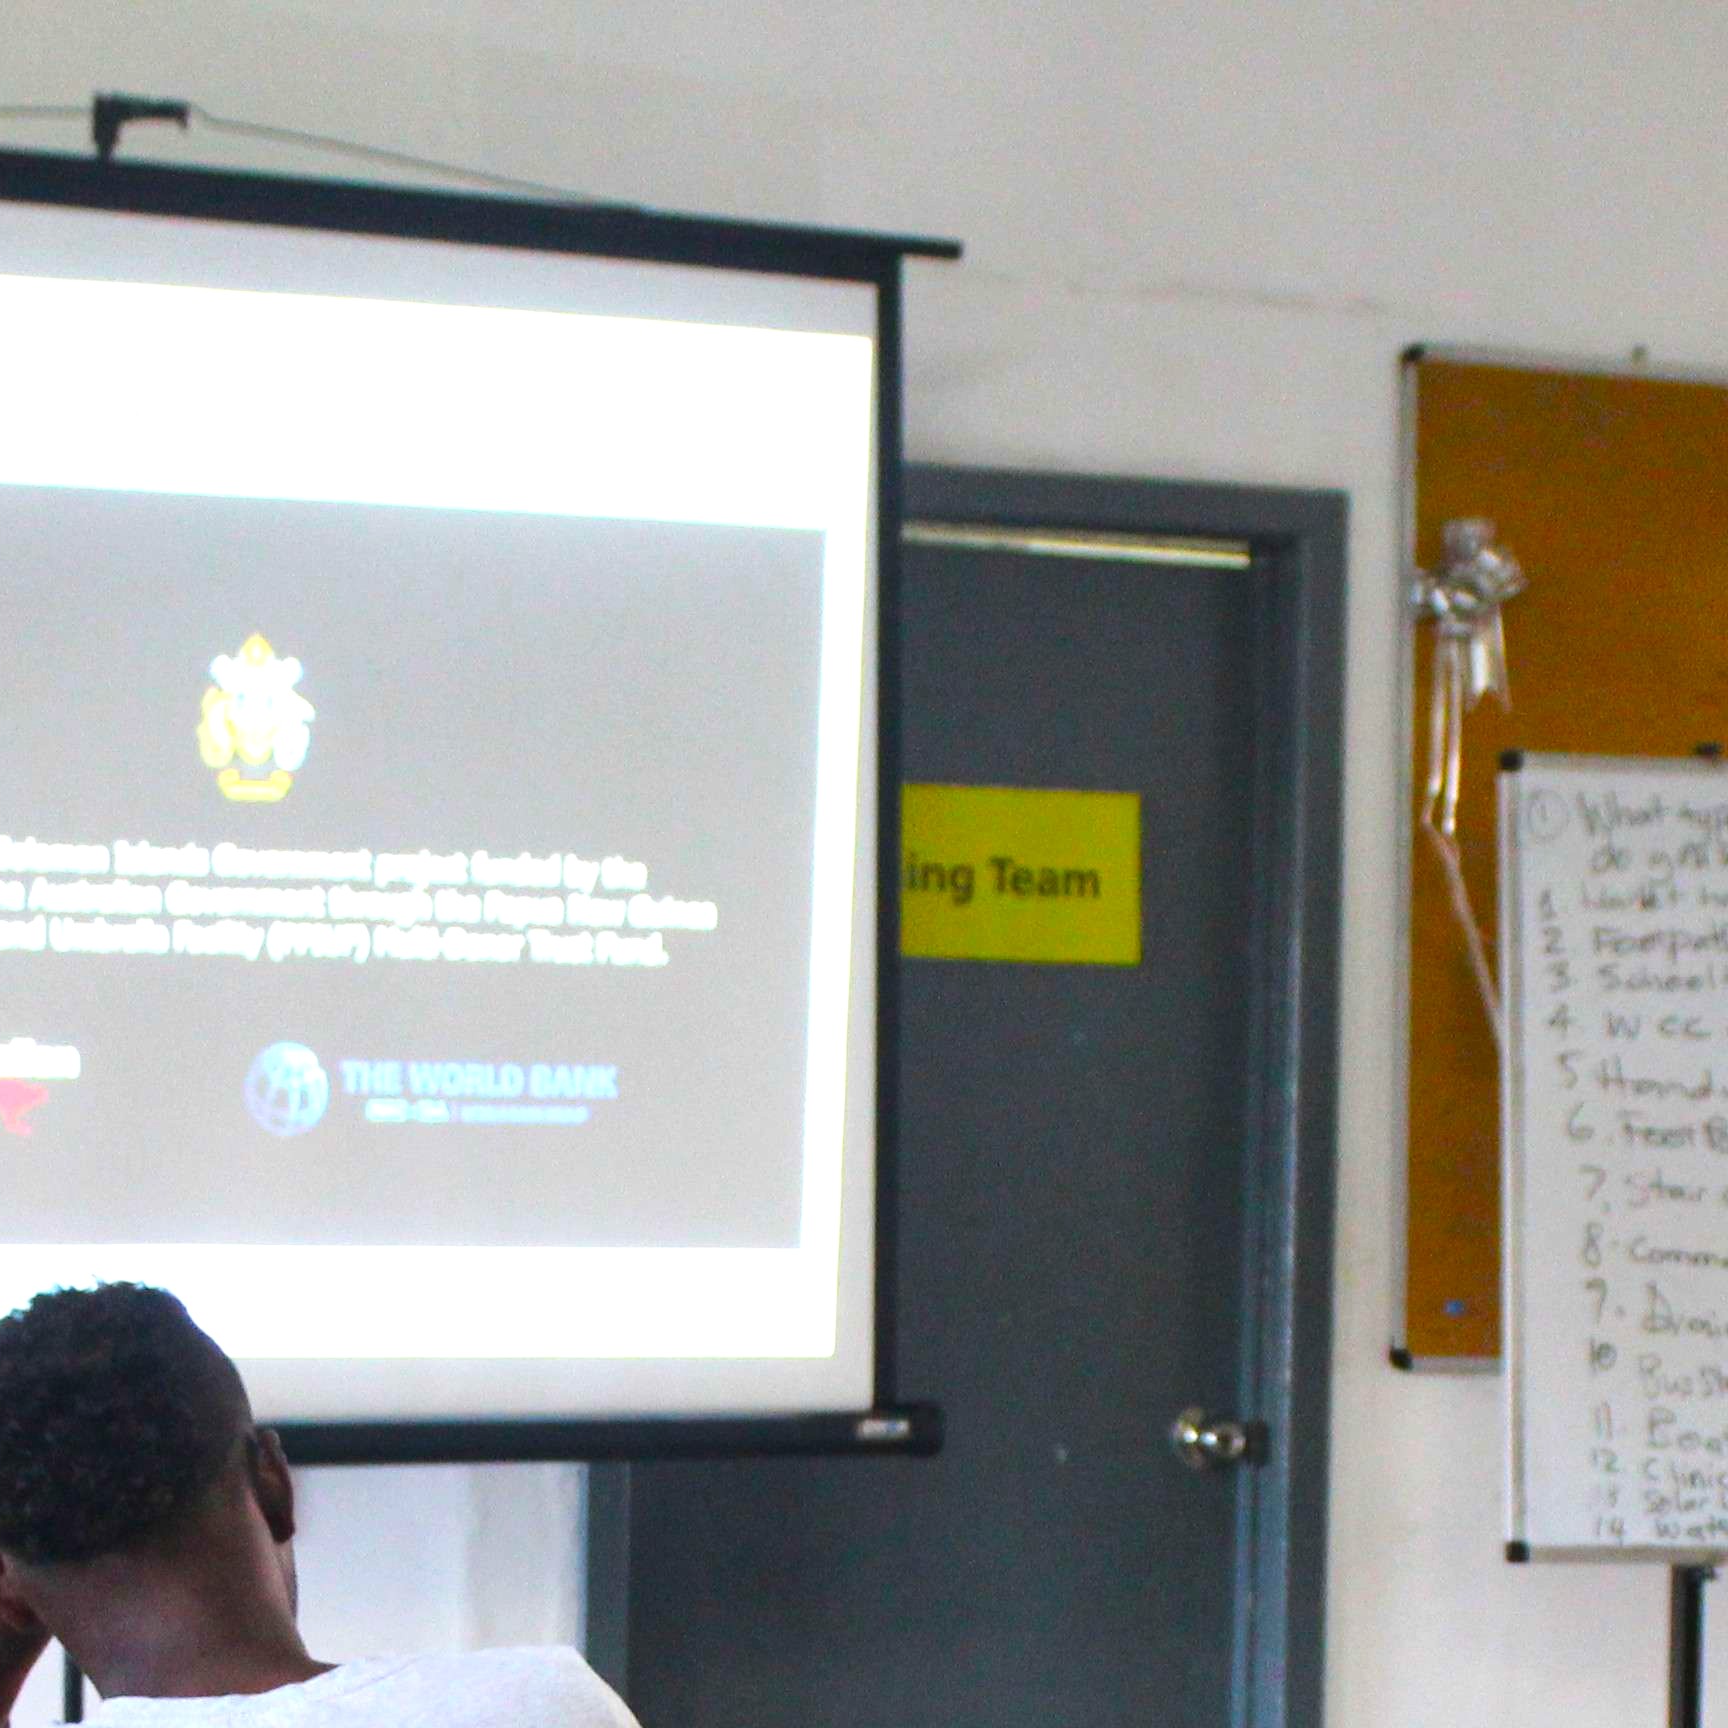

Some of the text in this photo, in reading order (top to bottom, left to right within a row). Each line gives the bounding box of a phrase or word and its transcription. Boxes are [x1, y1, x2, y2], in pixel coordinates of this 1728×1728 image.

[1575, 792, 1662, 836] What
[906, 852, 1101, 907] ing Team
[340, 1060, 618, 1100] THE WORLD BANK
